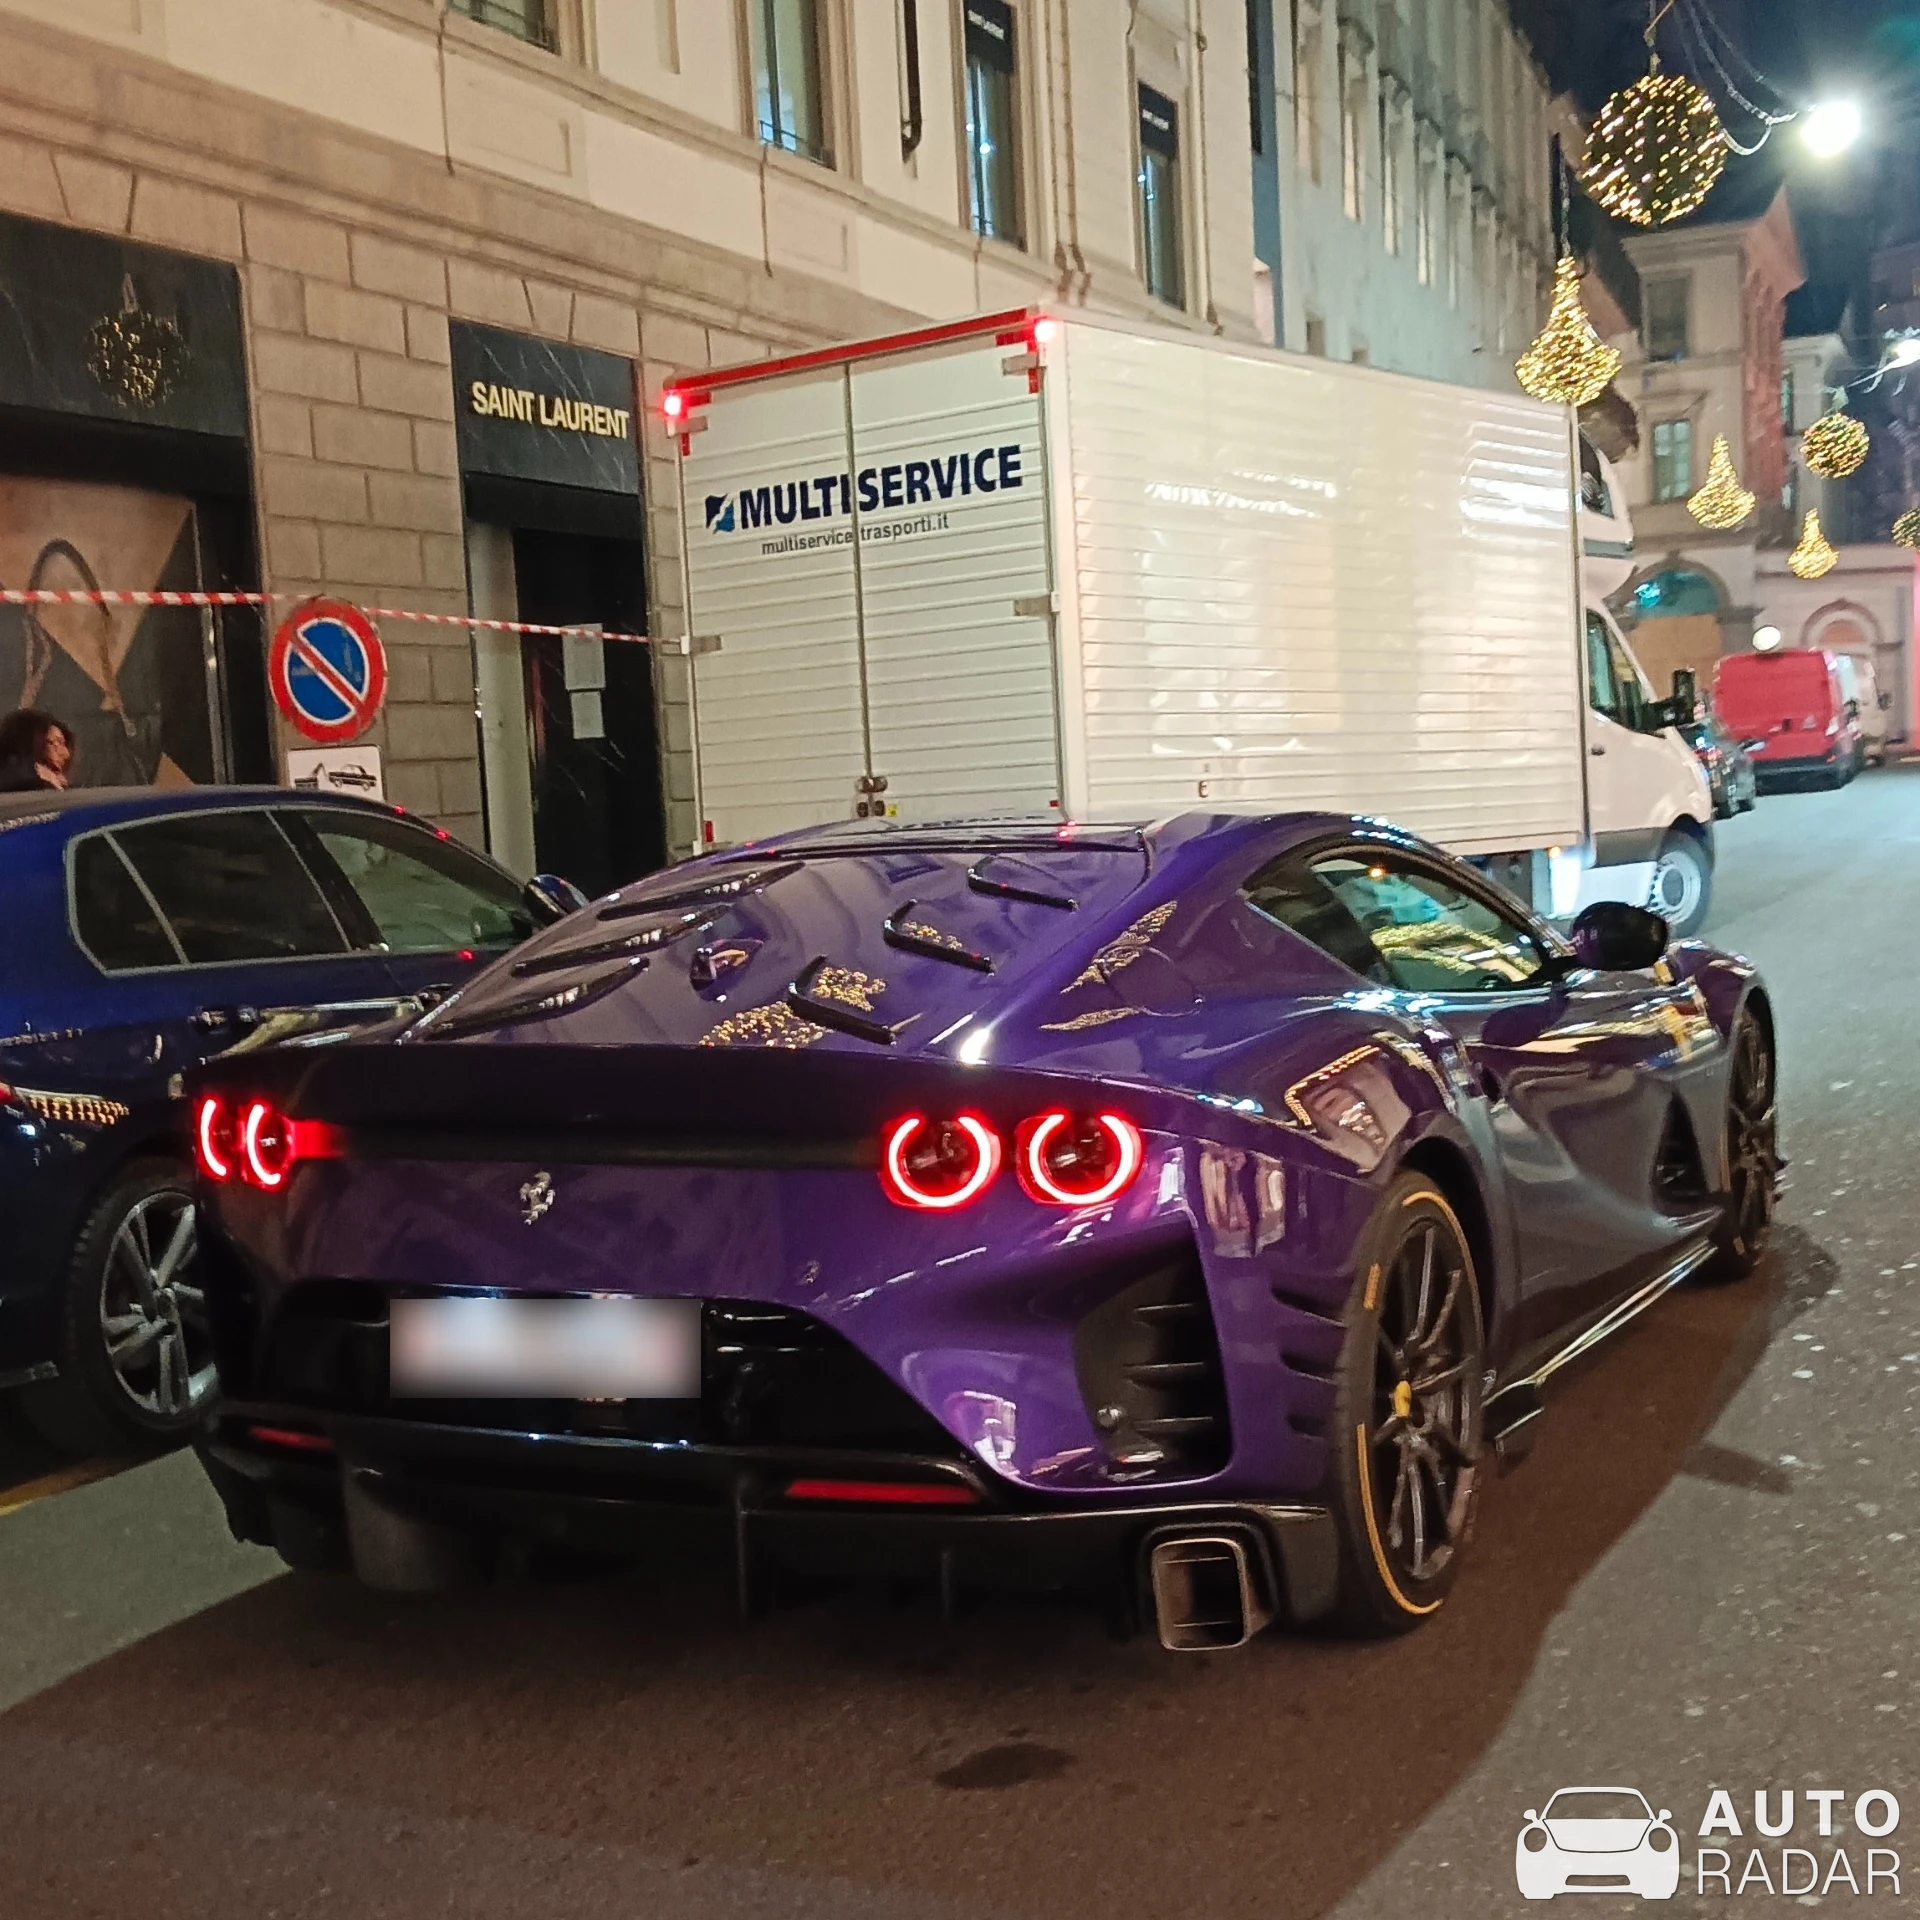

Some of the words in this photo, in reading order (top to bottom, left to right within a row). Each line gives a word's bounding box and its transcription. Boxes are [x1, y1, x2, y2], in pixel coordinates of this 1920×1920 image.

[472, 381, 534, 424] SAINT
[539, 394, 630, 440] LAURENT
[739, 444, 1023, 530] MULTISERVICE
